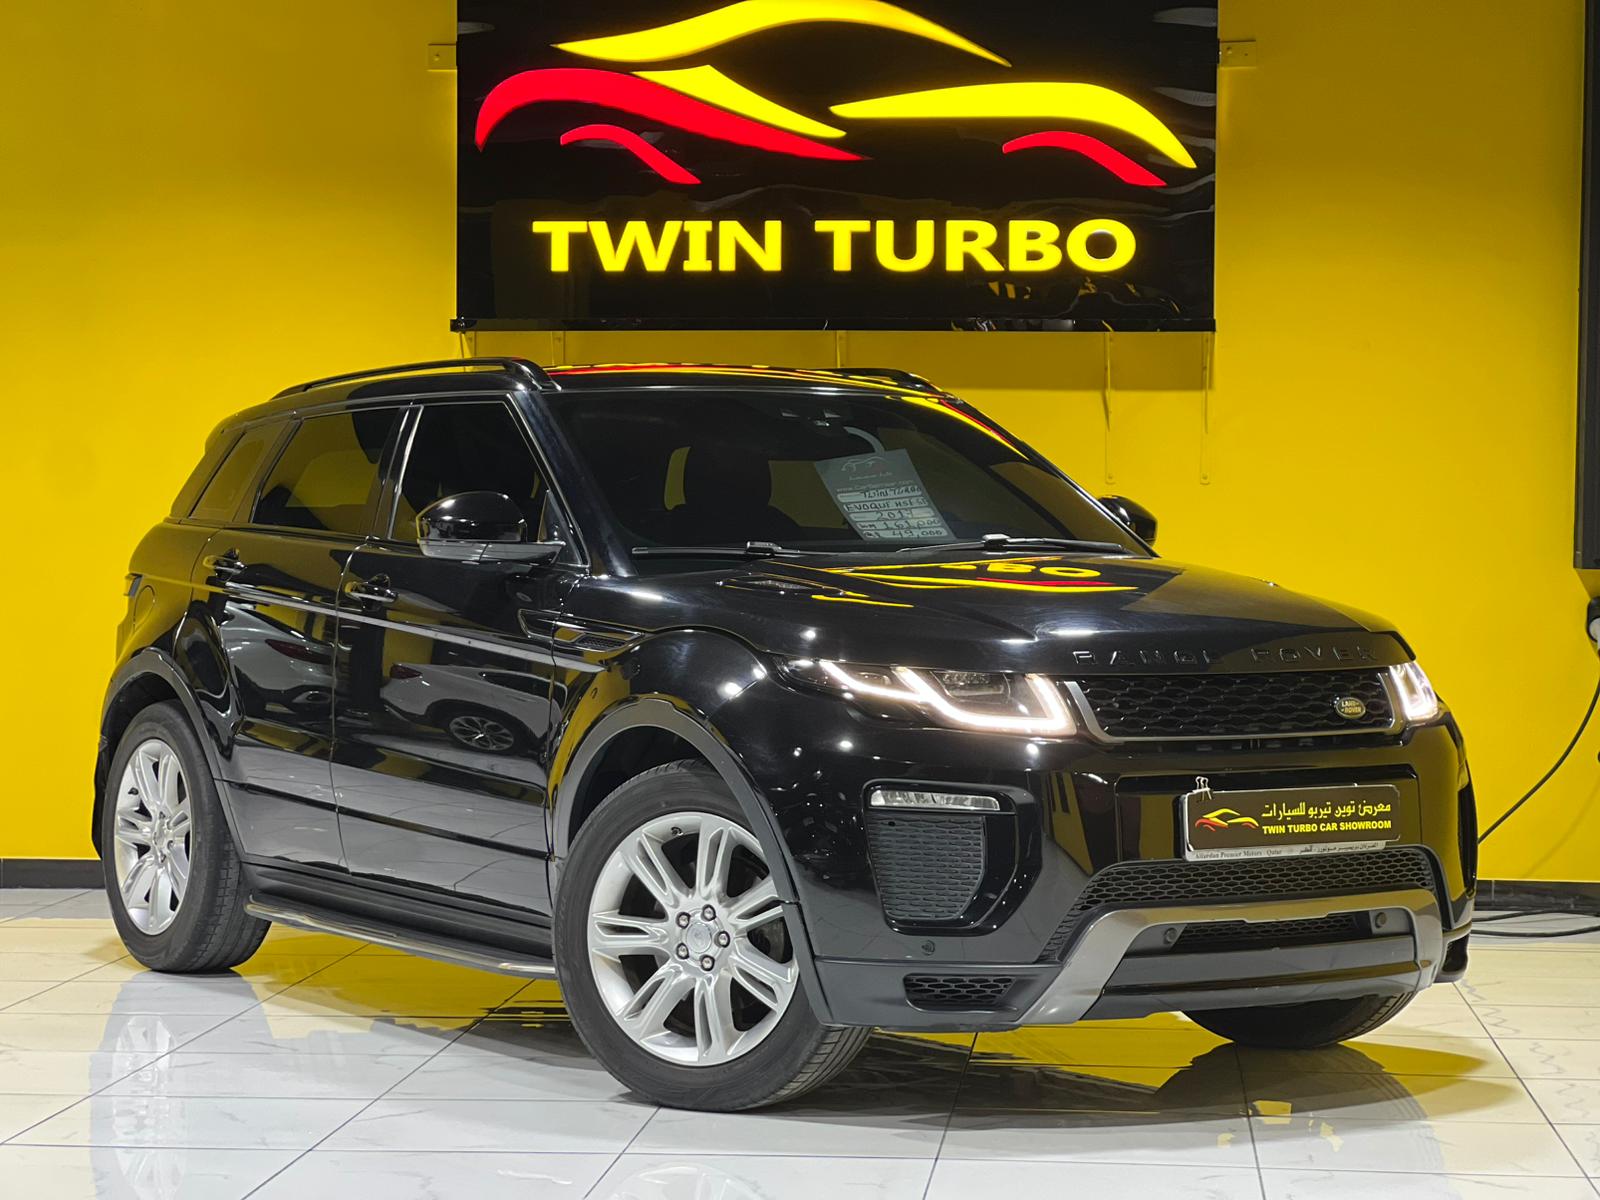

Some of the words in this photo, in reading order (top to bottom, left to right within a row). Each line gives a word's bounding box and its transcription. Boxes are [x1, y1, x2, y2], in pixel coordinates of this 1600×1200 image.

[532, 219, 782, 273] TWIN
[814, 218, 1137, 274] TURBO
[1250, 646, 1378, 665] ROVER
[1261, 801, 1306, 820] للسيارات
[1308, 802, 1331, 819] تيربو
[1334, 801, 1356, 817] توين
[1358, 800, 1391, 816] معرض
[1262, 825, 1286, 835] TWIN
[1288, 823, 1318, 833] TURBO
[1319, 823, 1338, 832] CAR
[1339, 820, 1392, 831] SHOWROOM
